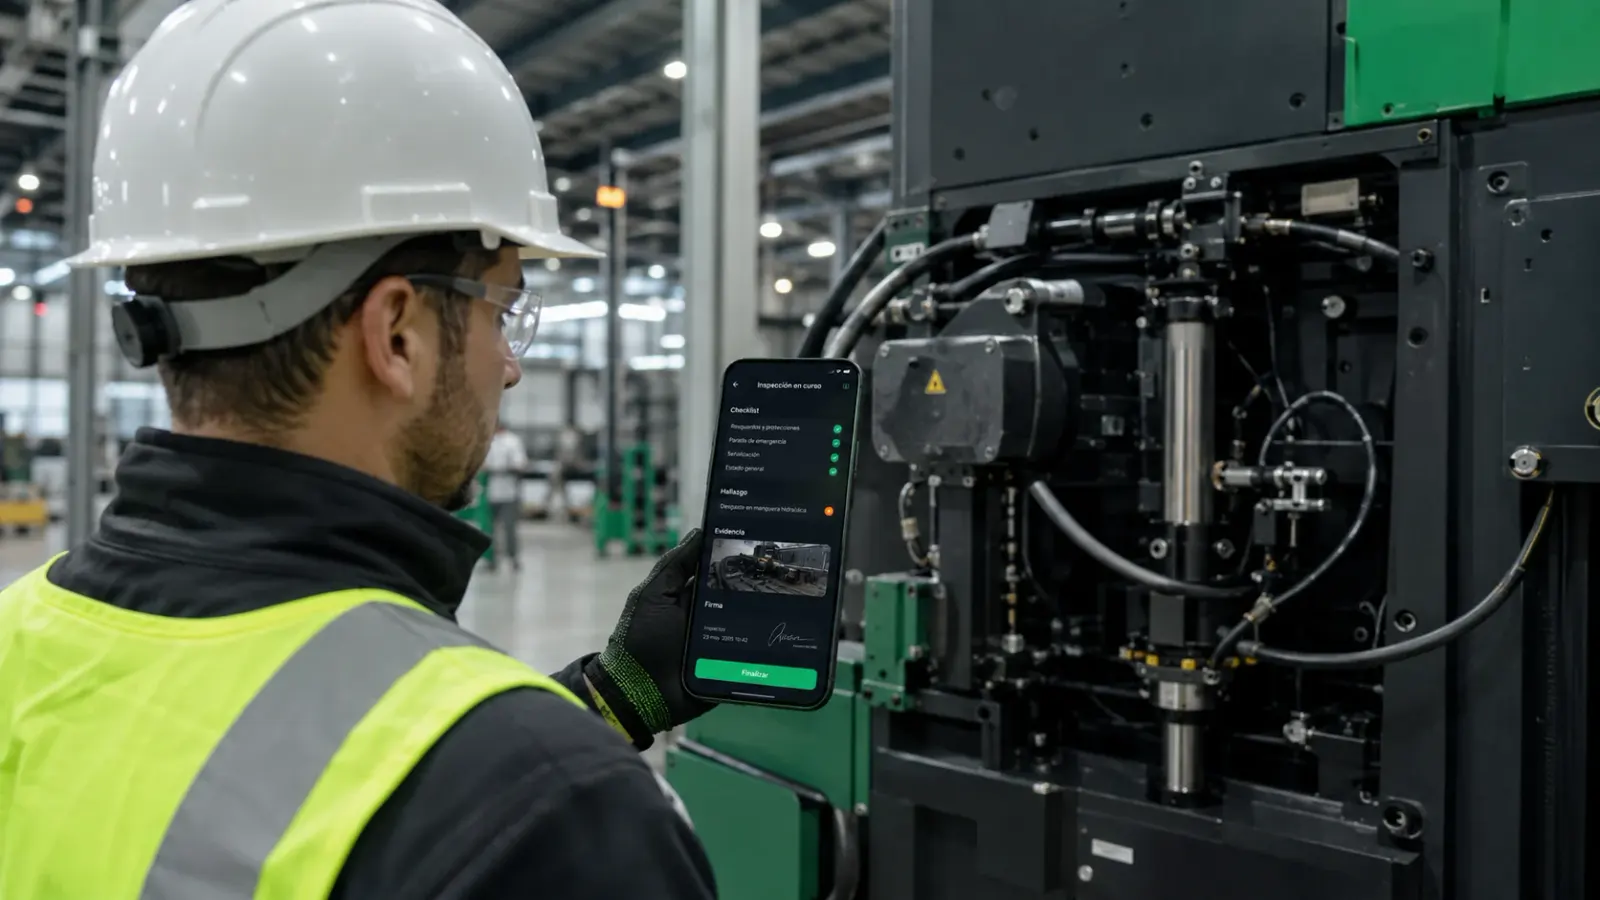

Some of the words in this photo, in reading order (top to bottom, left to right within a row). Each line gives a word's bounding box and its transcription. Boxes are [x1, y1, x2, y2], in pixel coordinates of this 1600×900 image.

[757, 381, 792, 389] Inspección
[755, 438, 787, 446] emergencia
[720, 488, 748, 497] Hallazgo
[753, 505, 781, 513] manguera
[714, 527, 746, 536] Evidencia
[704, 600, 724, 609] Firma
[741, 668, 769, 679] Finalizar
